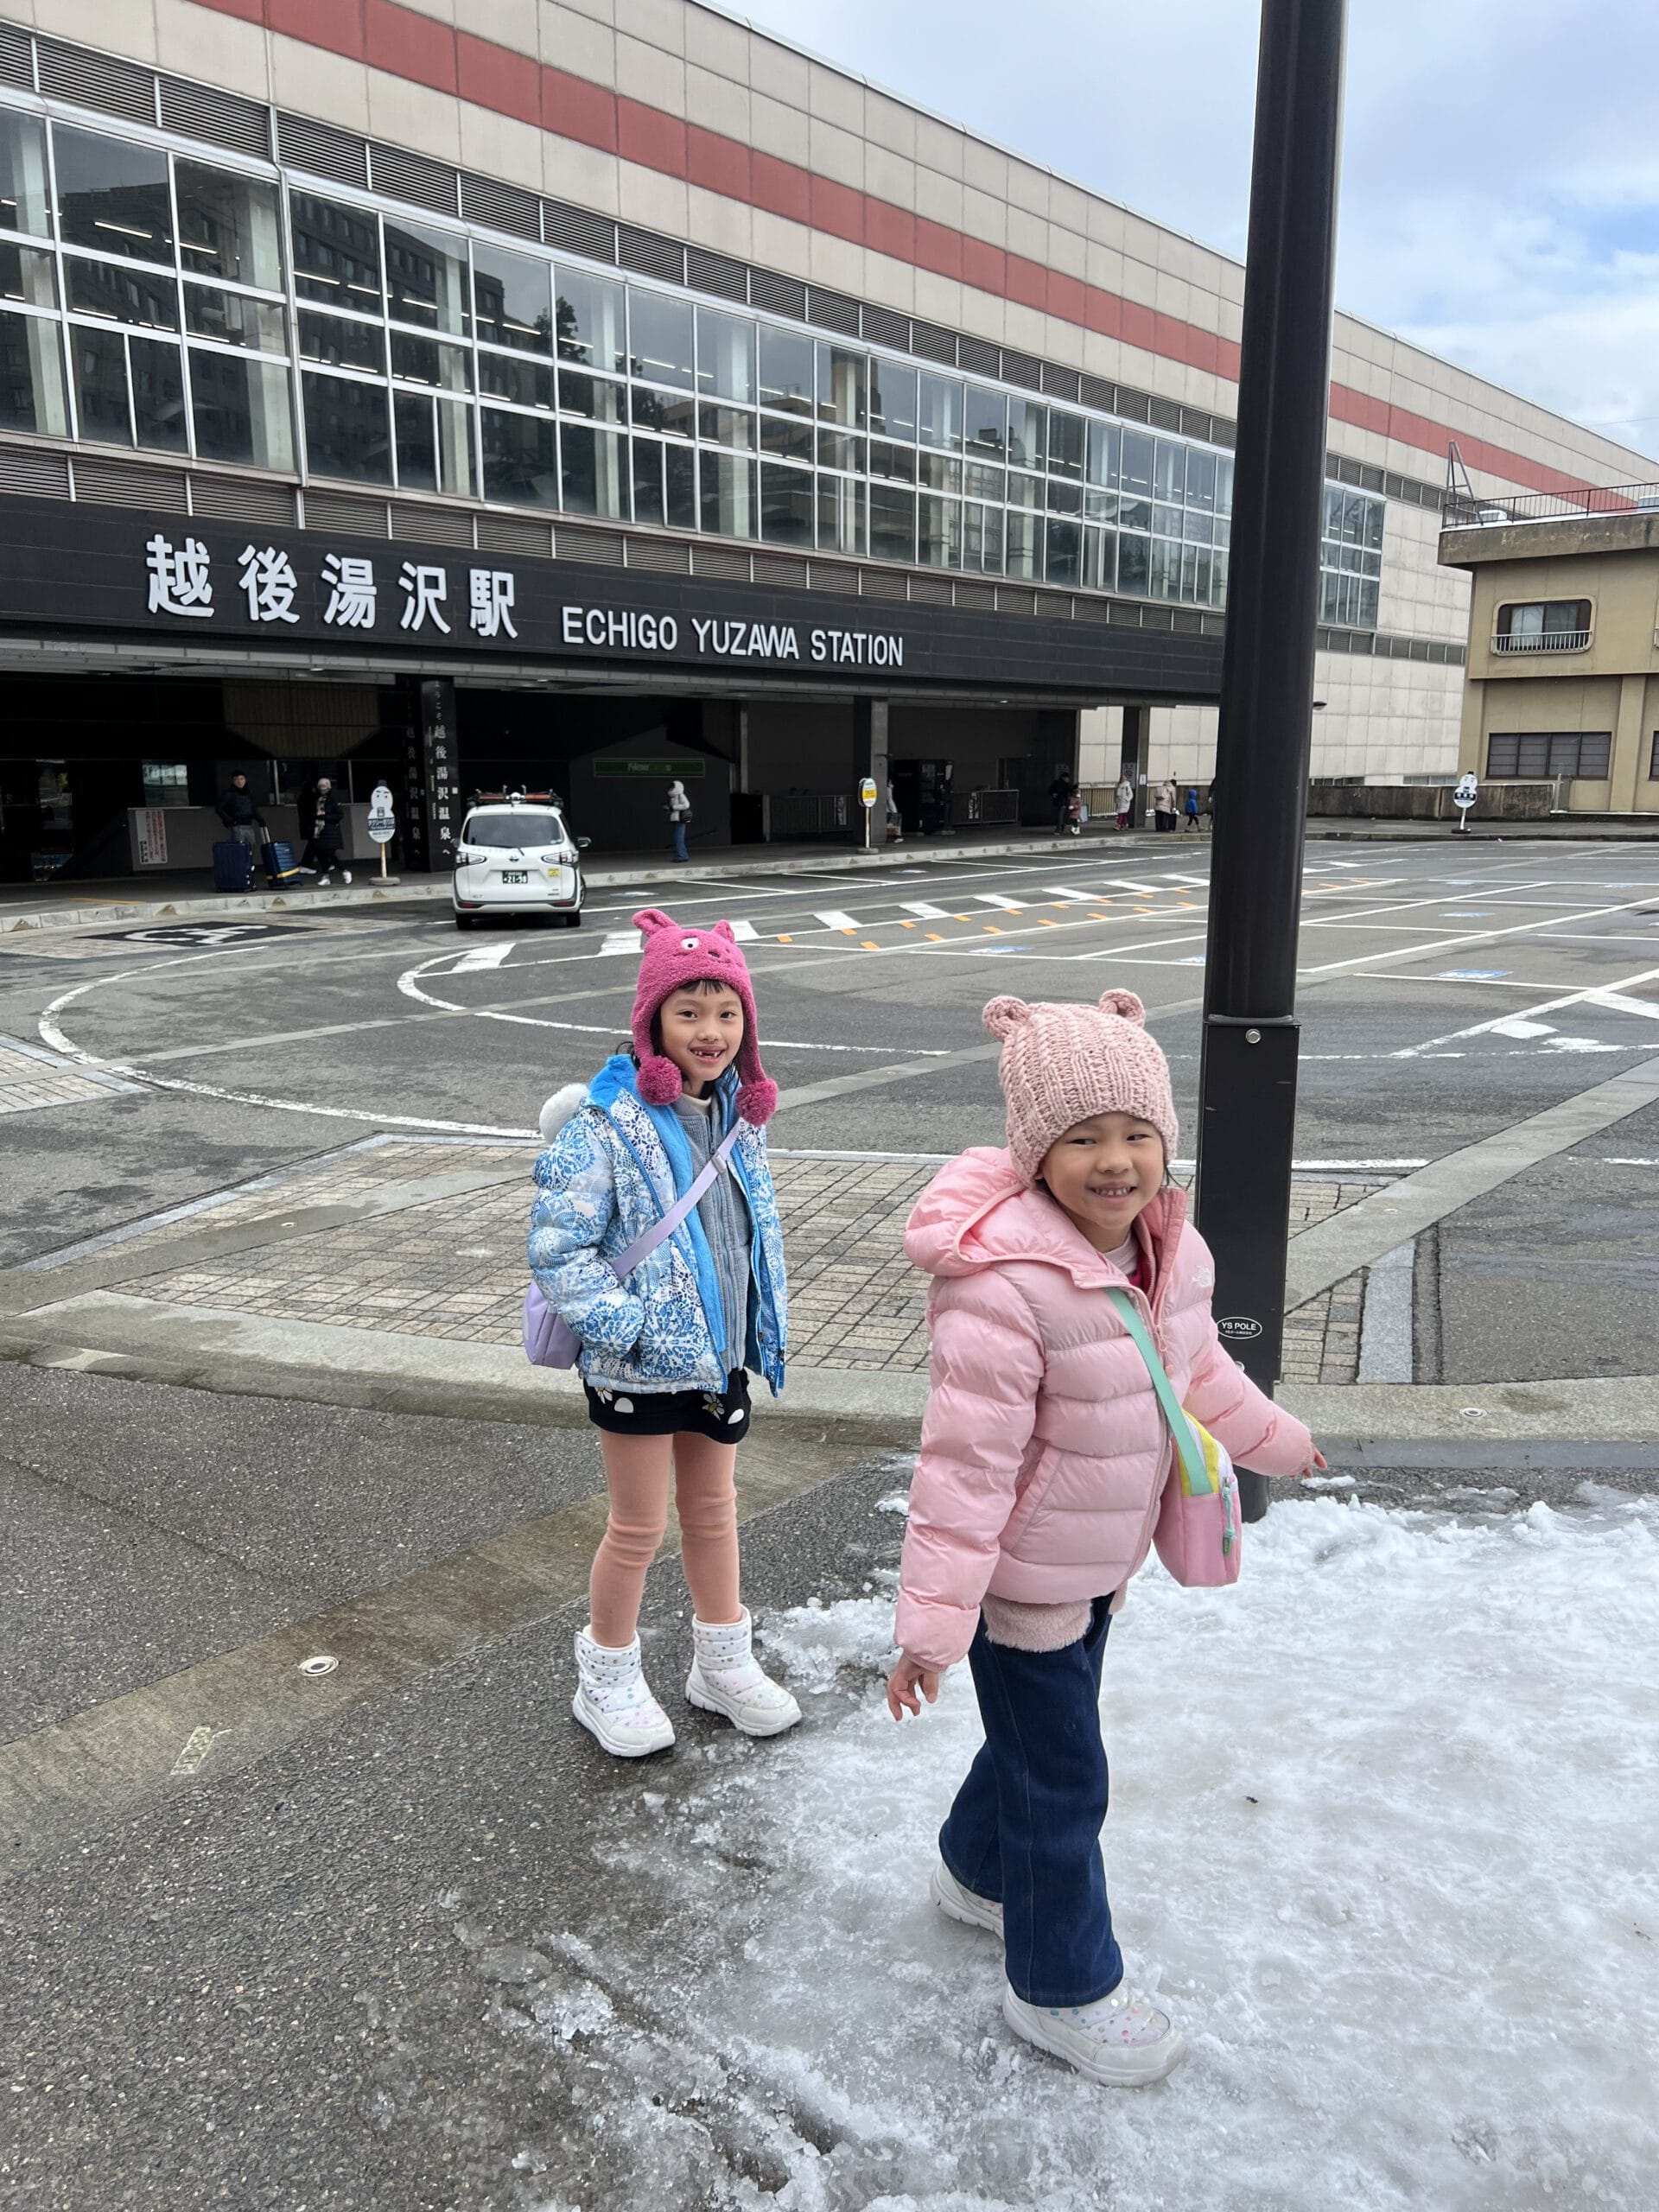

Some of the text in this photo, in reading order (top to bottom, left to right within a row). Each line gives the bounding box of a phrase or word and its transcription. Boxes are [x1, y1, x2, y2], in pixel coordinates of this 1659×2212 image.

[146, 534, 518, 639] 越後湯沢駅
[563, 607, 903, 666] ECHIGO YUZAWA STATION
[1234, 1322, 1256, 1331] POLE
